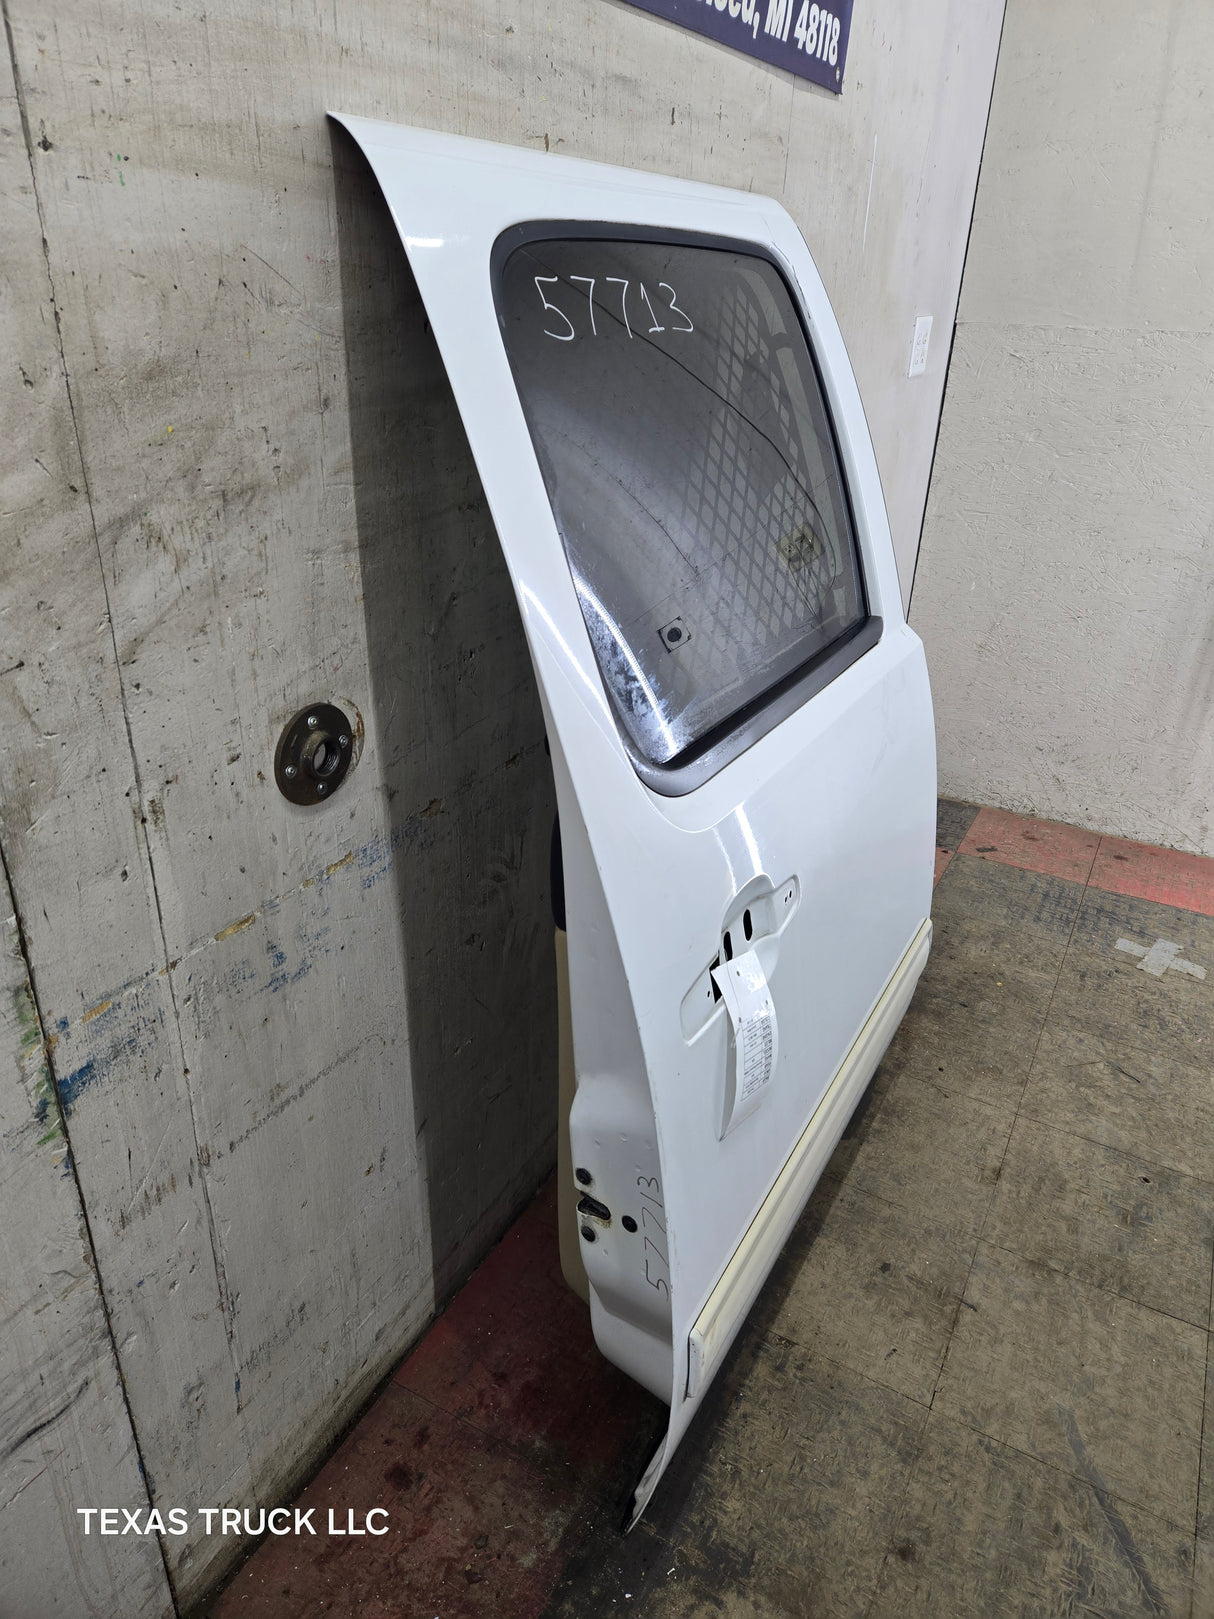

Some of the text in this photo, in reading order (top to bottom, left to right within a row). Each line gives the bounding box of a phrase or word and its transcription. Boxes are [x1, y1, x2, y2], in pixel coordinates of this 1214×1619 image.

[764, 0, 794, 42] MI
[794, 0, 841, 66] 48118
[534, 275, 694, 341] 57713
[636, 1175, 670, 1302] 57713
